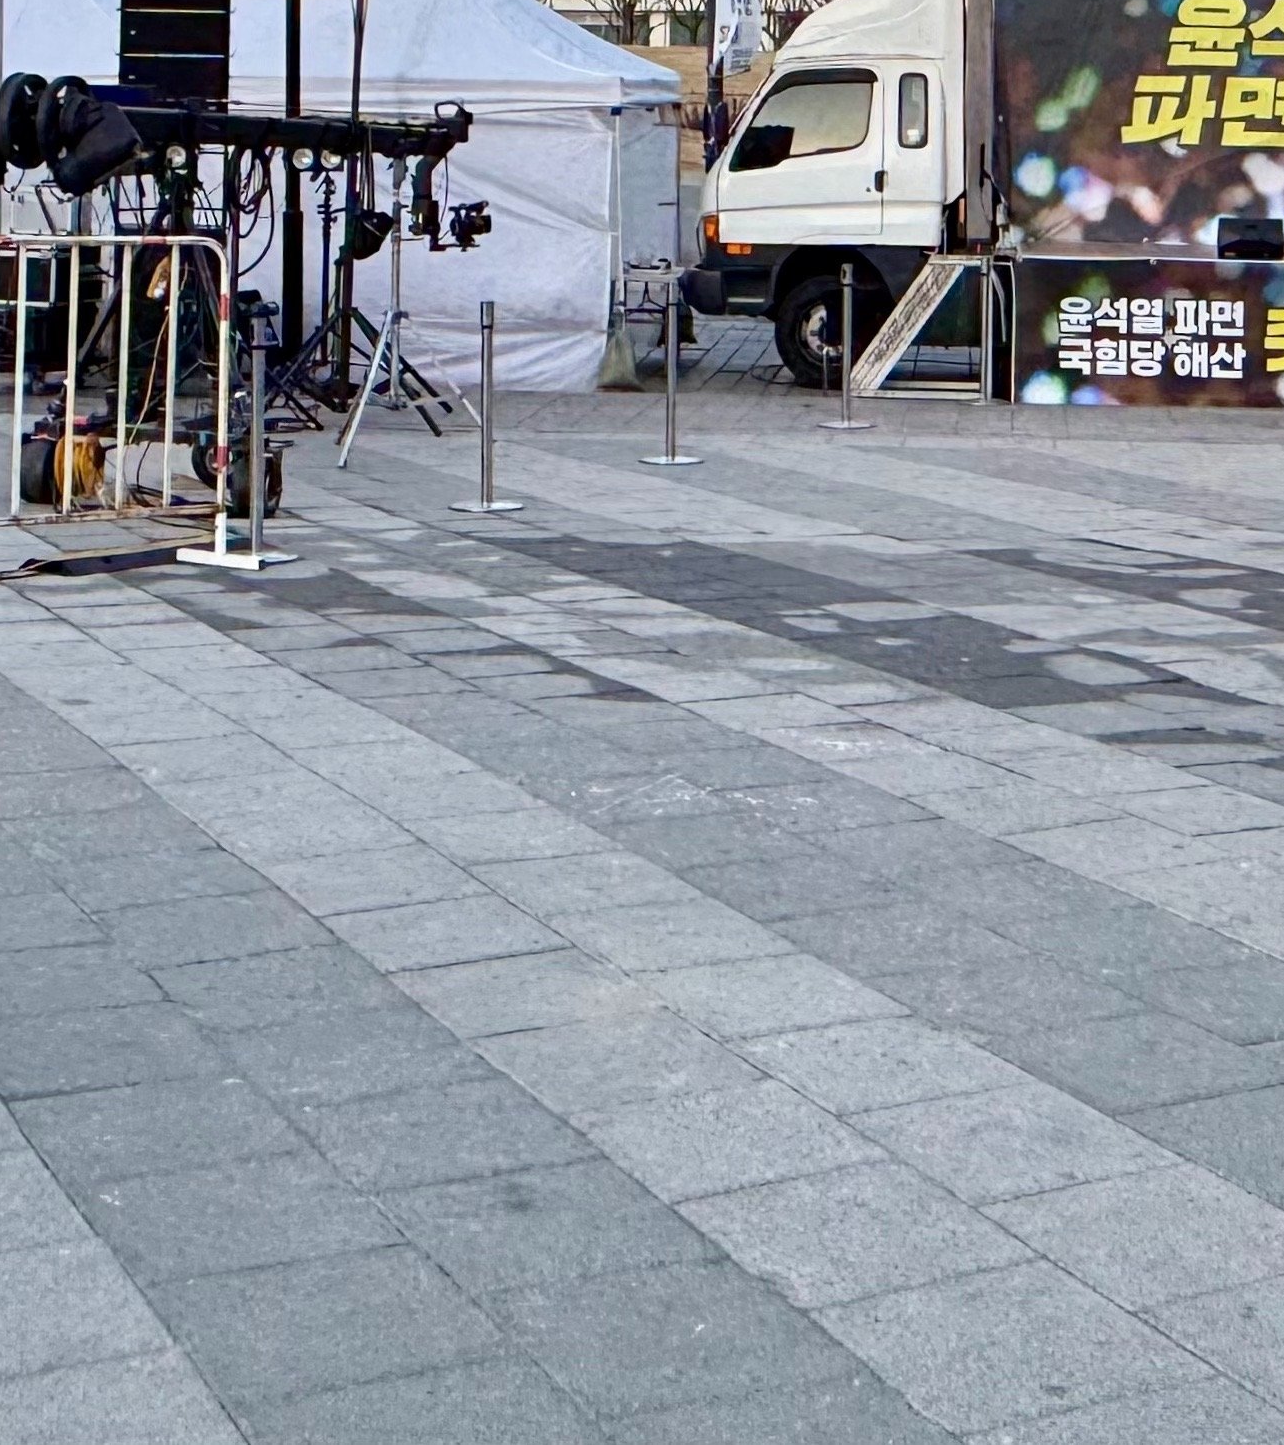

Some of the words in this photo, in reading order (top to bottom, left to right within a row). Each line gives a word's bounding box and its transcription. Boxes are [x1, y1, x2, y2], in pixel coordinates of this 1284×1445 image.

[1058, 296, 1164, 335] 윤석열
[1174, 299, 1245, 337] 파면
[1058, 338, 1166, 377] 국힘당
[1173, 342, 1247, 380] 해산
